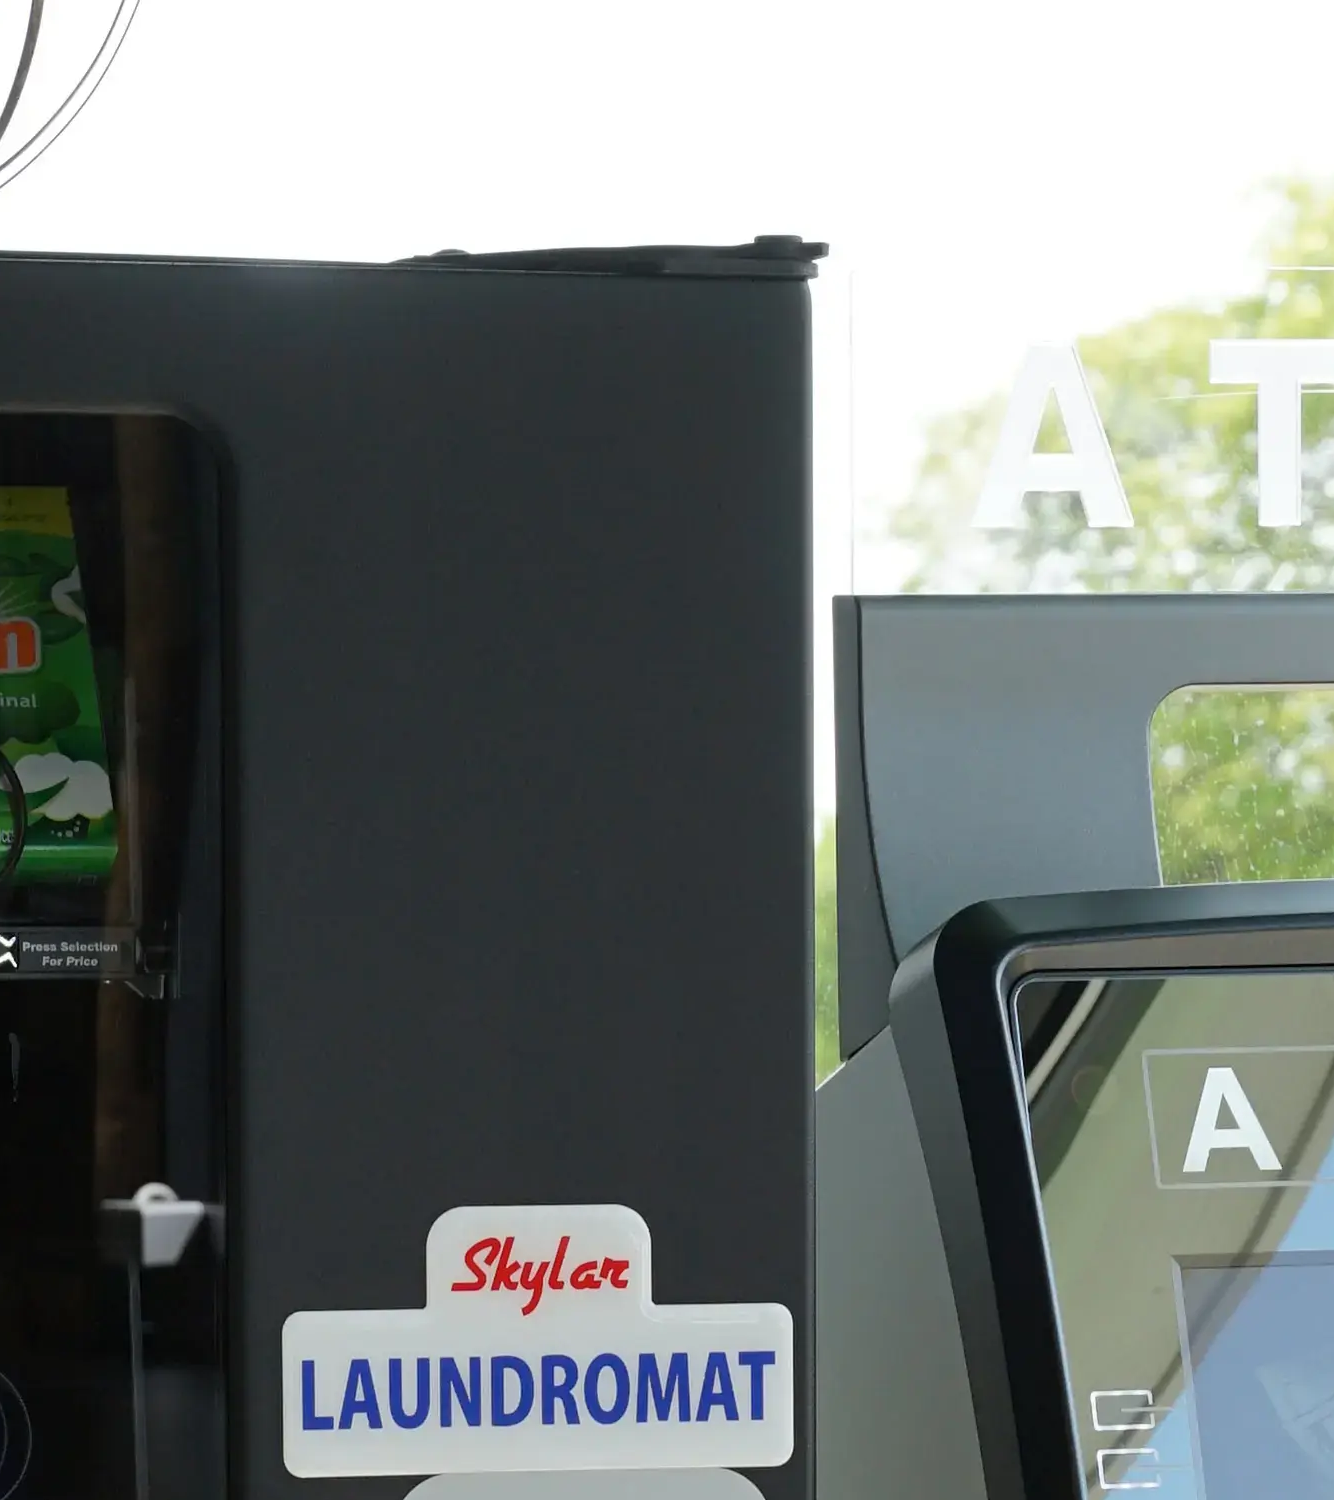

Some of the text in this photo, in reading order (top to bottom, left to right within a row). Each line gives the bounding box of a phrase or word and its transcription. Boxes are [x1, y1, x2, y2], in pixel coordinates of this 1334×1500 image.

[22, 941, 118, 953] Press Selection
[42, 956, 98, 967] For Price
[451, 1236, 630, 1315] Skylar
[300, 1350, 776, 1431] LAUNDROMAT
